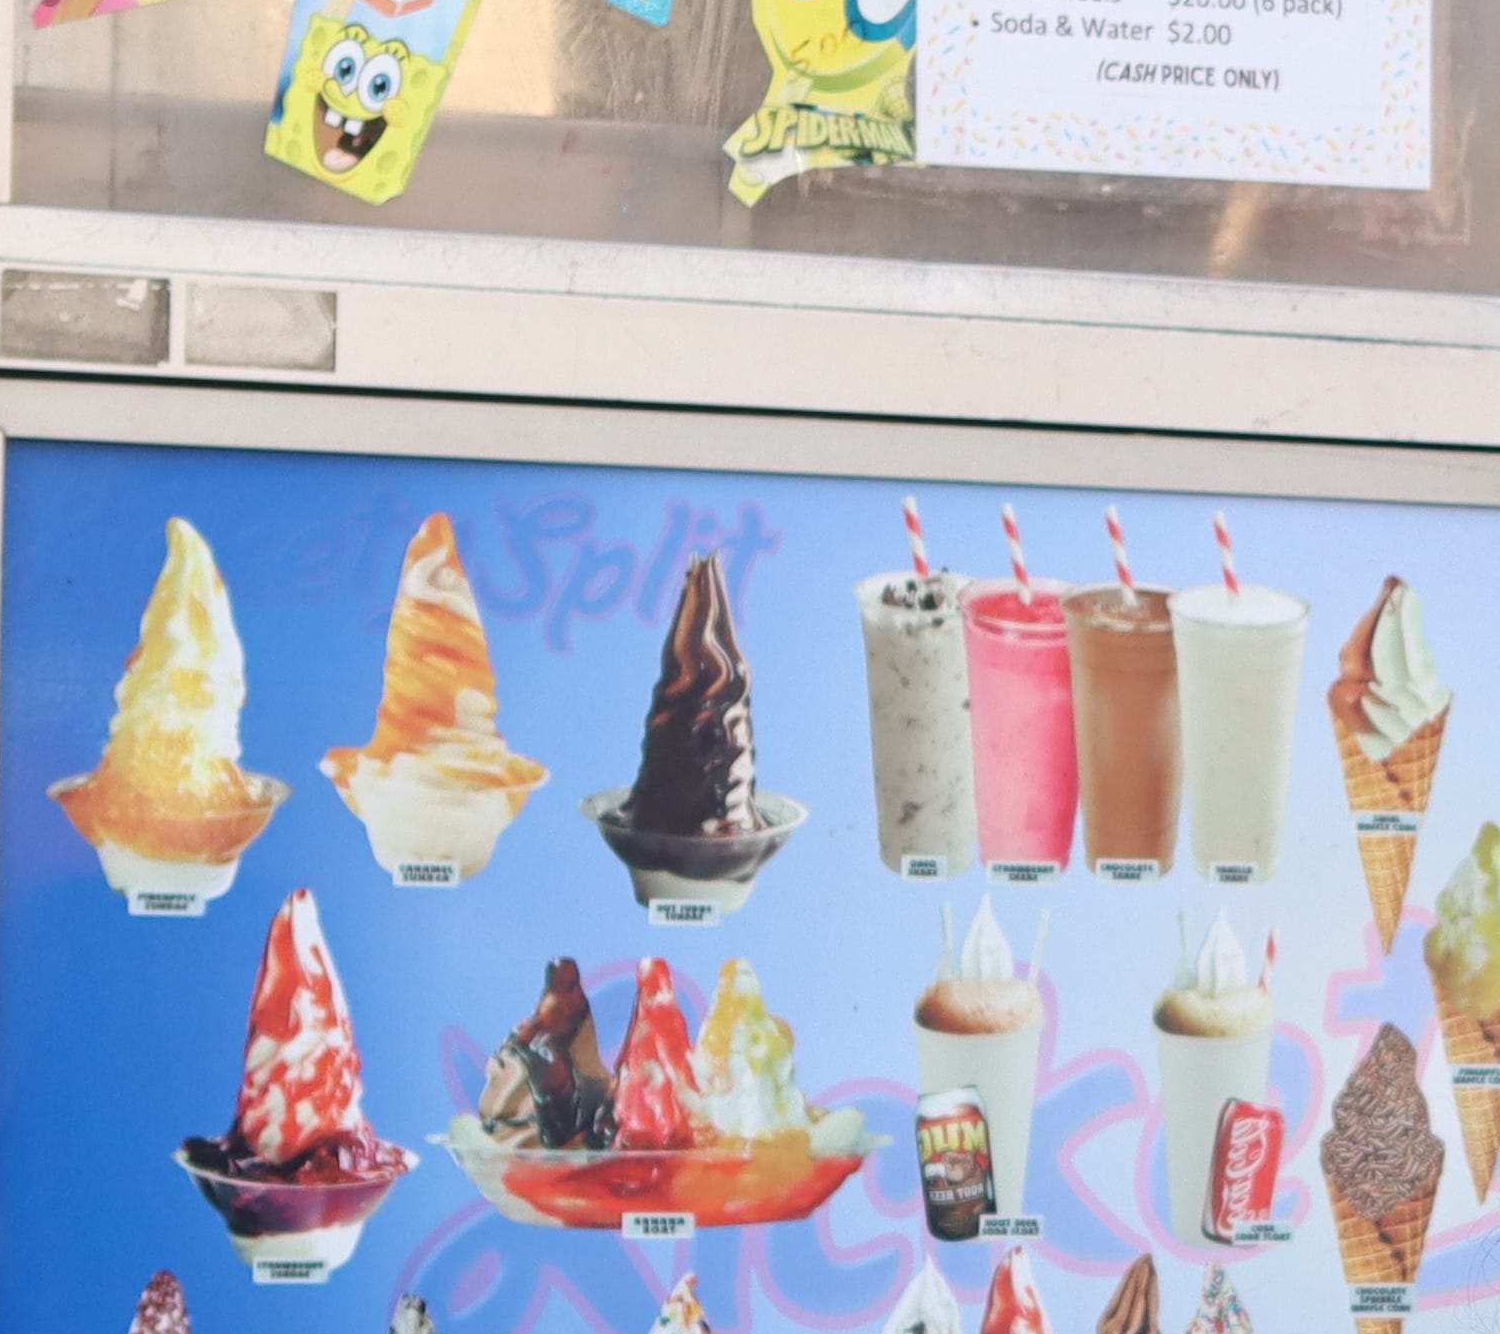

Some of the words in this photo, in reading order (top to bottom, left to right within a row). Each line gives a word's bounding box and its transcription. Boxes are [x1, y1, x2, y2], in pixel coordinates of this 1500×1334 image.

[990, 14, 1047, 36] Soda
[1056, 17, 1073, 37] &
[1082, 18, 1154, 41] Water
[1167, 21, 1231, 46] $2.00
[1097, 61, 1157, 83] (CASH
[1161, 65, 1215, 86] PRICE
[1224, 69, 1279, 91] ONLY)
